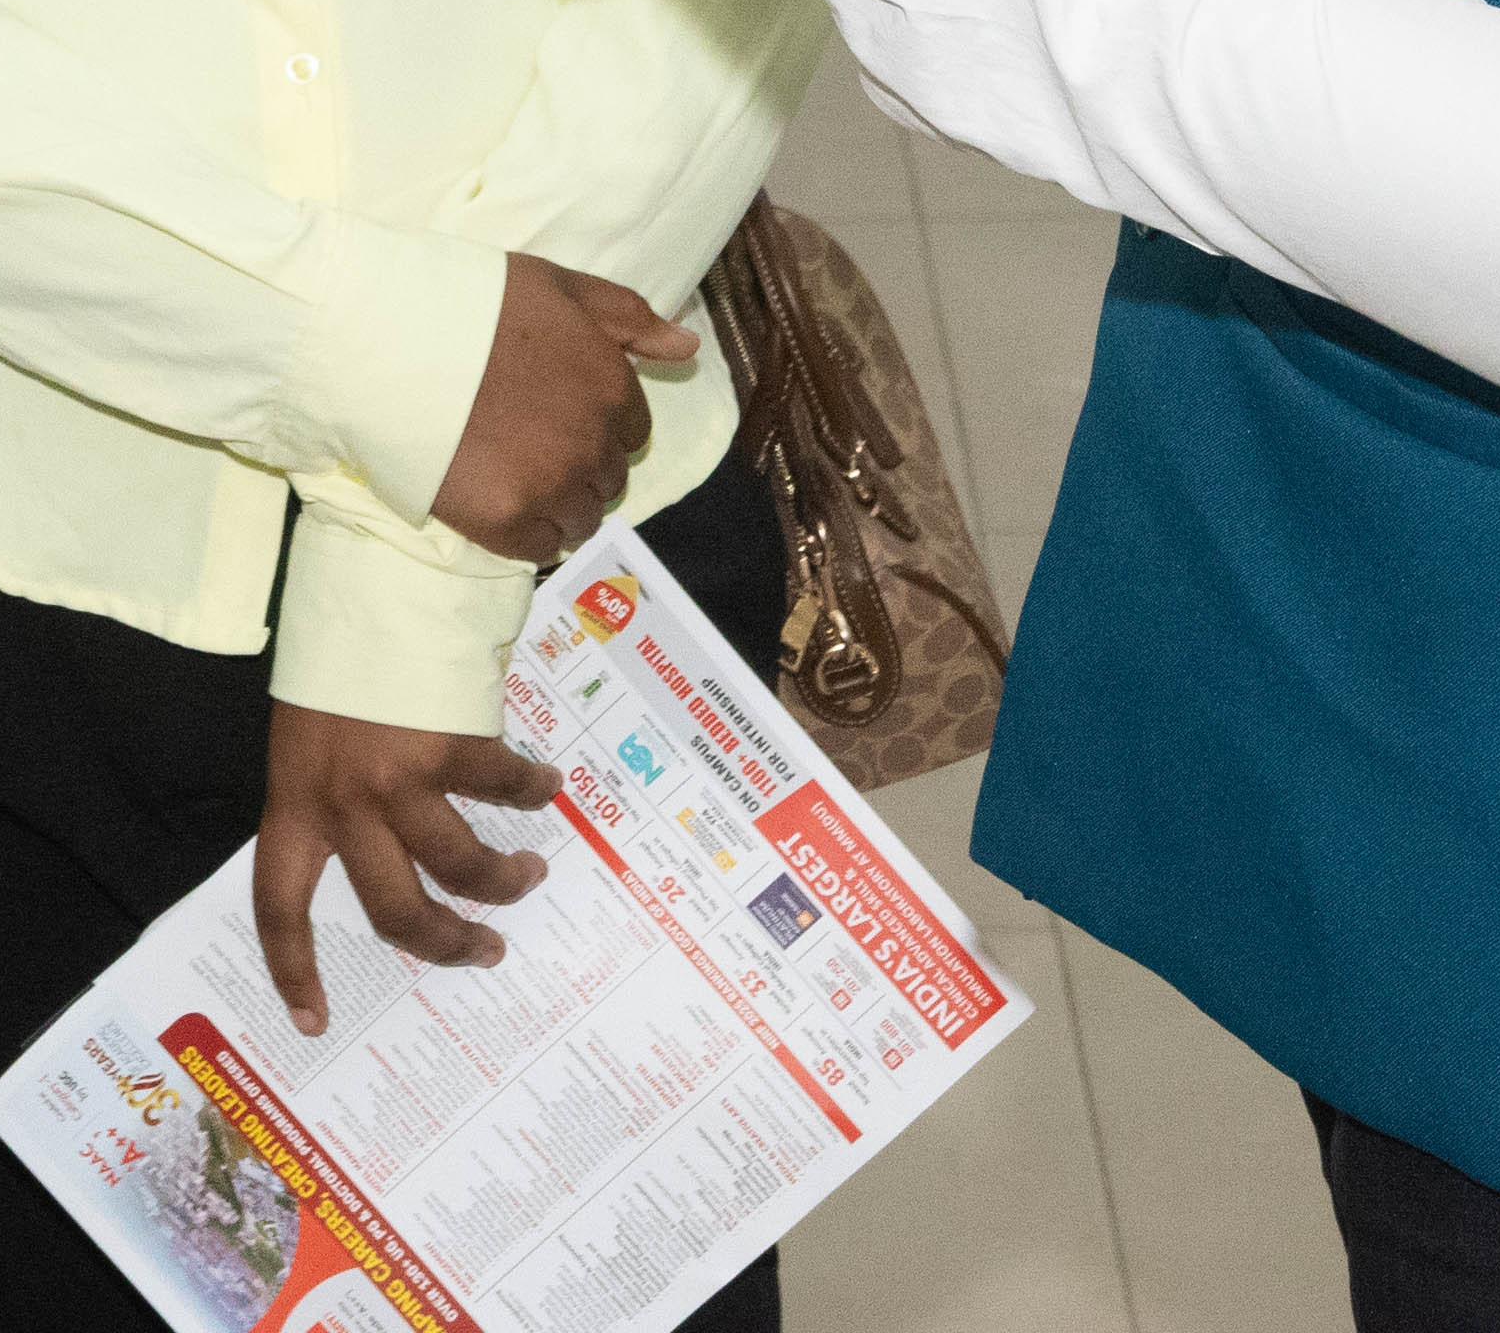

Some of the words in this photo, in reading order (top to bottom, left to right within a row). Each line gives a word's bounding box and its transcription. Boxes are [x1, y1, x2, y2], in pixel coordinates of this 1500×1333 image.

[593, 587, 630, 619] 50%
[631, 632, 695, 702] HOSPITAL
[684, 693, 741, 755] BEDDED
[698, 673, 772, 755] INTERNSHIP
[688, 733, 743, 794] CAMPUS
[731, 747, 780, 799] 1100+
[765, 750, 796, 783] FOR
[565, 762, 627, 829] 101-150
[737, 789, 761, 814] ON
[808, 798, 859, 853] MM(DU)
[618, 867, 653, 905] INDIA)
[775, 825, 884, 946] LARGEST
[842, 865, 858, 882] &
[851, 848, 871, 868] AT
[645, 898, 666, 920] OF
[851, 876, 883, 911] SKILL
[863, 861, 934, 940] LABORATORY
[877, 906, 936, 972] ADVANCED
[688, 947, 739, 1004] RANKINGS
[870, 933, 966, 1038] INDIA'S
[927, 933, 994, 1008] SIMULATION
[930, 966, 980, 1020] CLINICAL
[80, 1035, 123, 1081] YEARS
[753, 1021, 781, 1051] NIRF
[175, 1042, 249, 1121] LEADERS
[213, 1047, 262, 1100] OFFERED
[254, 1091, 314, 1157] PROGRAMS
[76, 1141, 121, 1190] NAAC
[236, 1110, 321, 1201] CREATING
[304, 1149, 364, 1214] DOCTORAL
[307, 1189, 394, 1285] CAREERS,
[382, 1275, 451, 1333] APING
[424, 1285, 461, 1324] OVER
